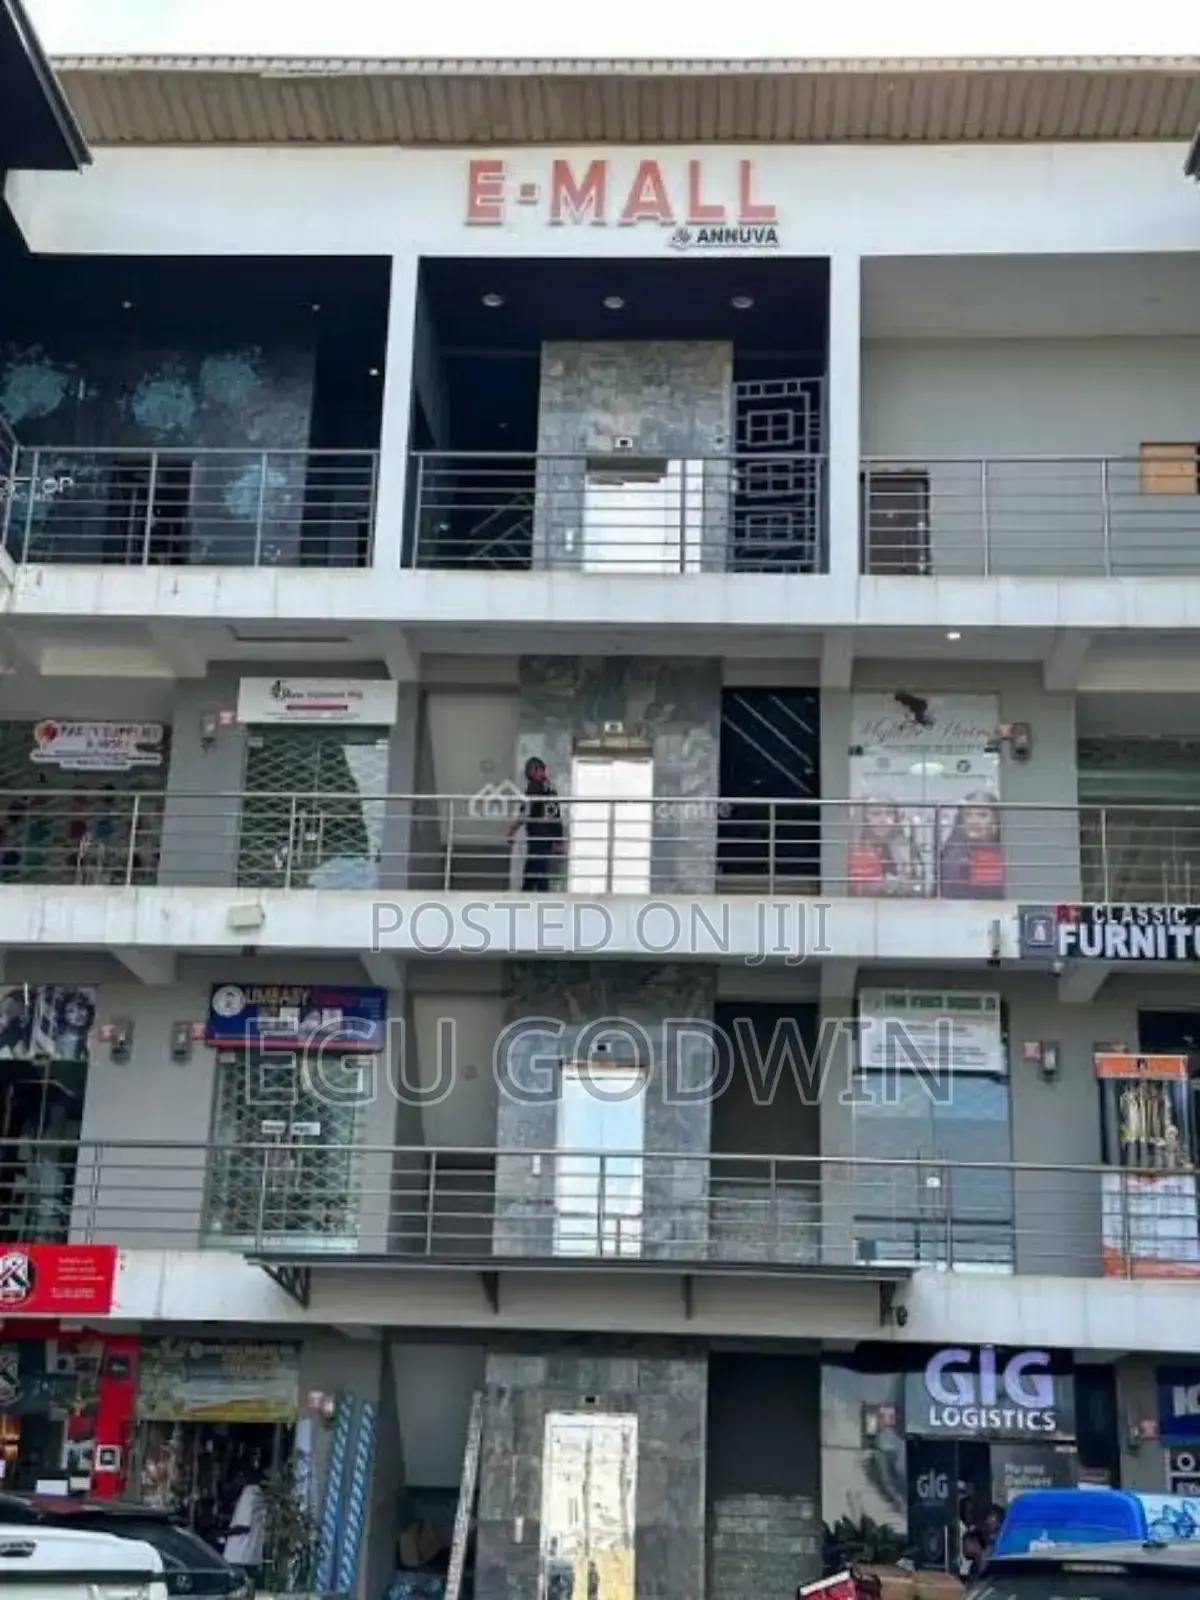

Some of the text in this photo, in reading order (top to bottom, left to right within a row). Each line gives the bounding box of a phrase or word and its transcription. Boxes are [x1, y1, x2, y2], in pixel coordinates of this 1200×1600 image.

[464, 159, 778, 227] E-MALL
[696, 227, 779, 244] ANNUVA
[1092, 904, 1187, 925] CLASSIC
[1059, 922, 1200, 959] FURNIT
[925, 1343, 1055, 1408] GIG
[929, 1405, 1057, 1432] LOGISTICS
[916, 1468, 949, 1499] GIG
